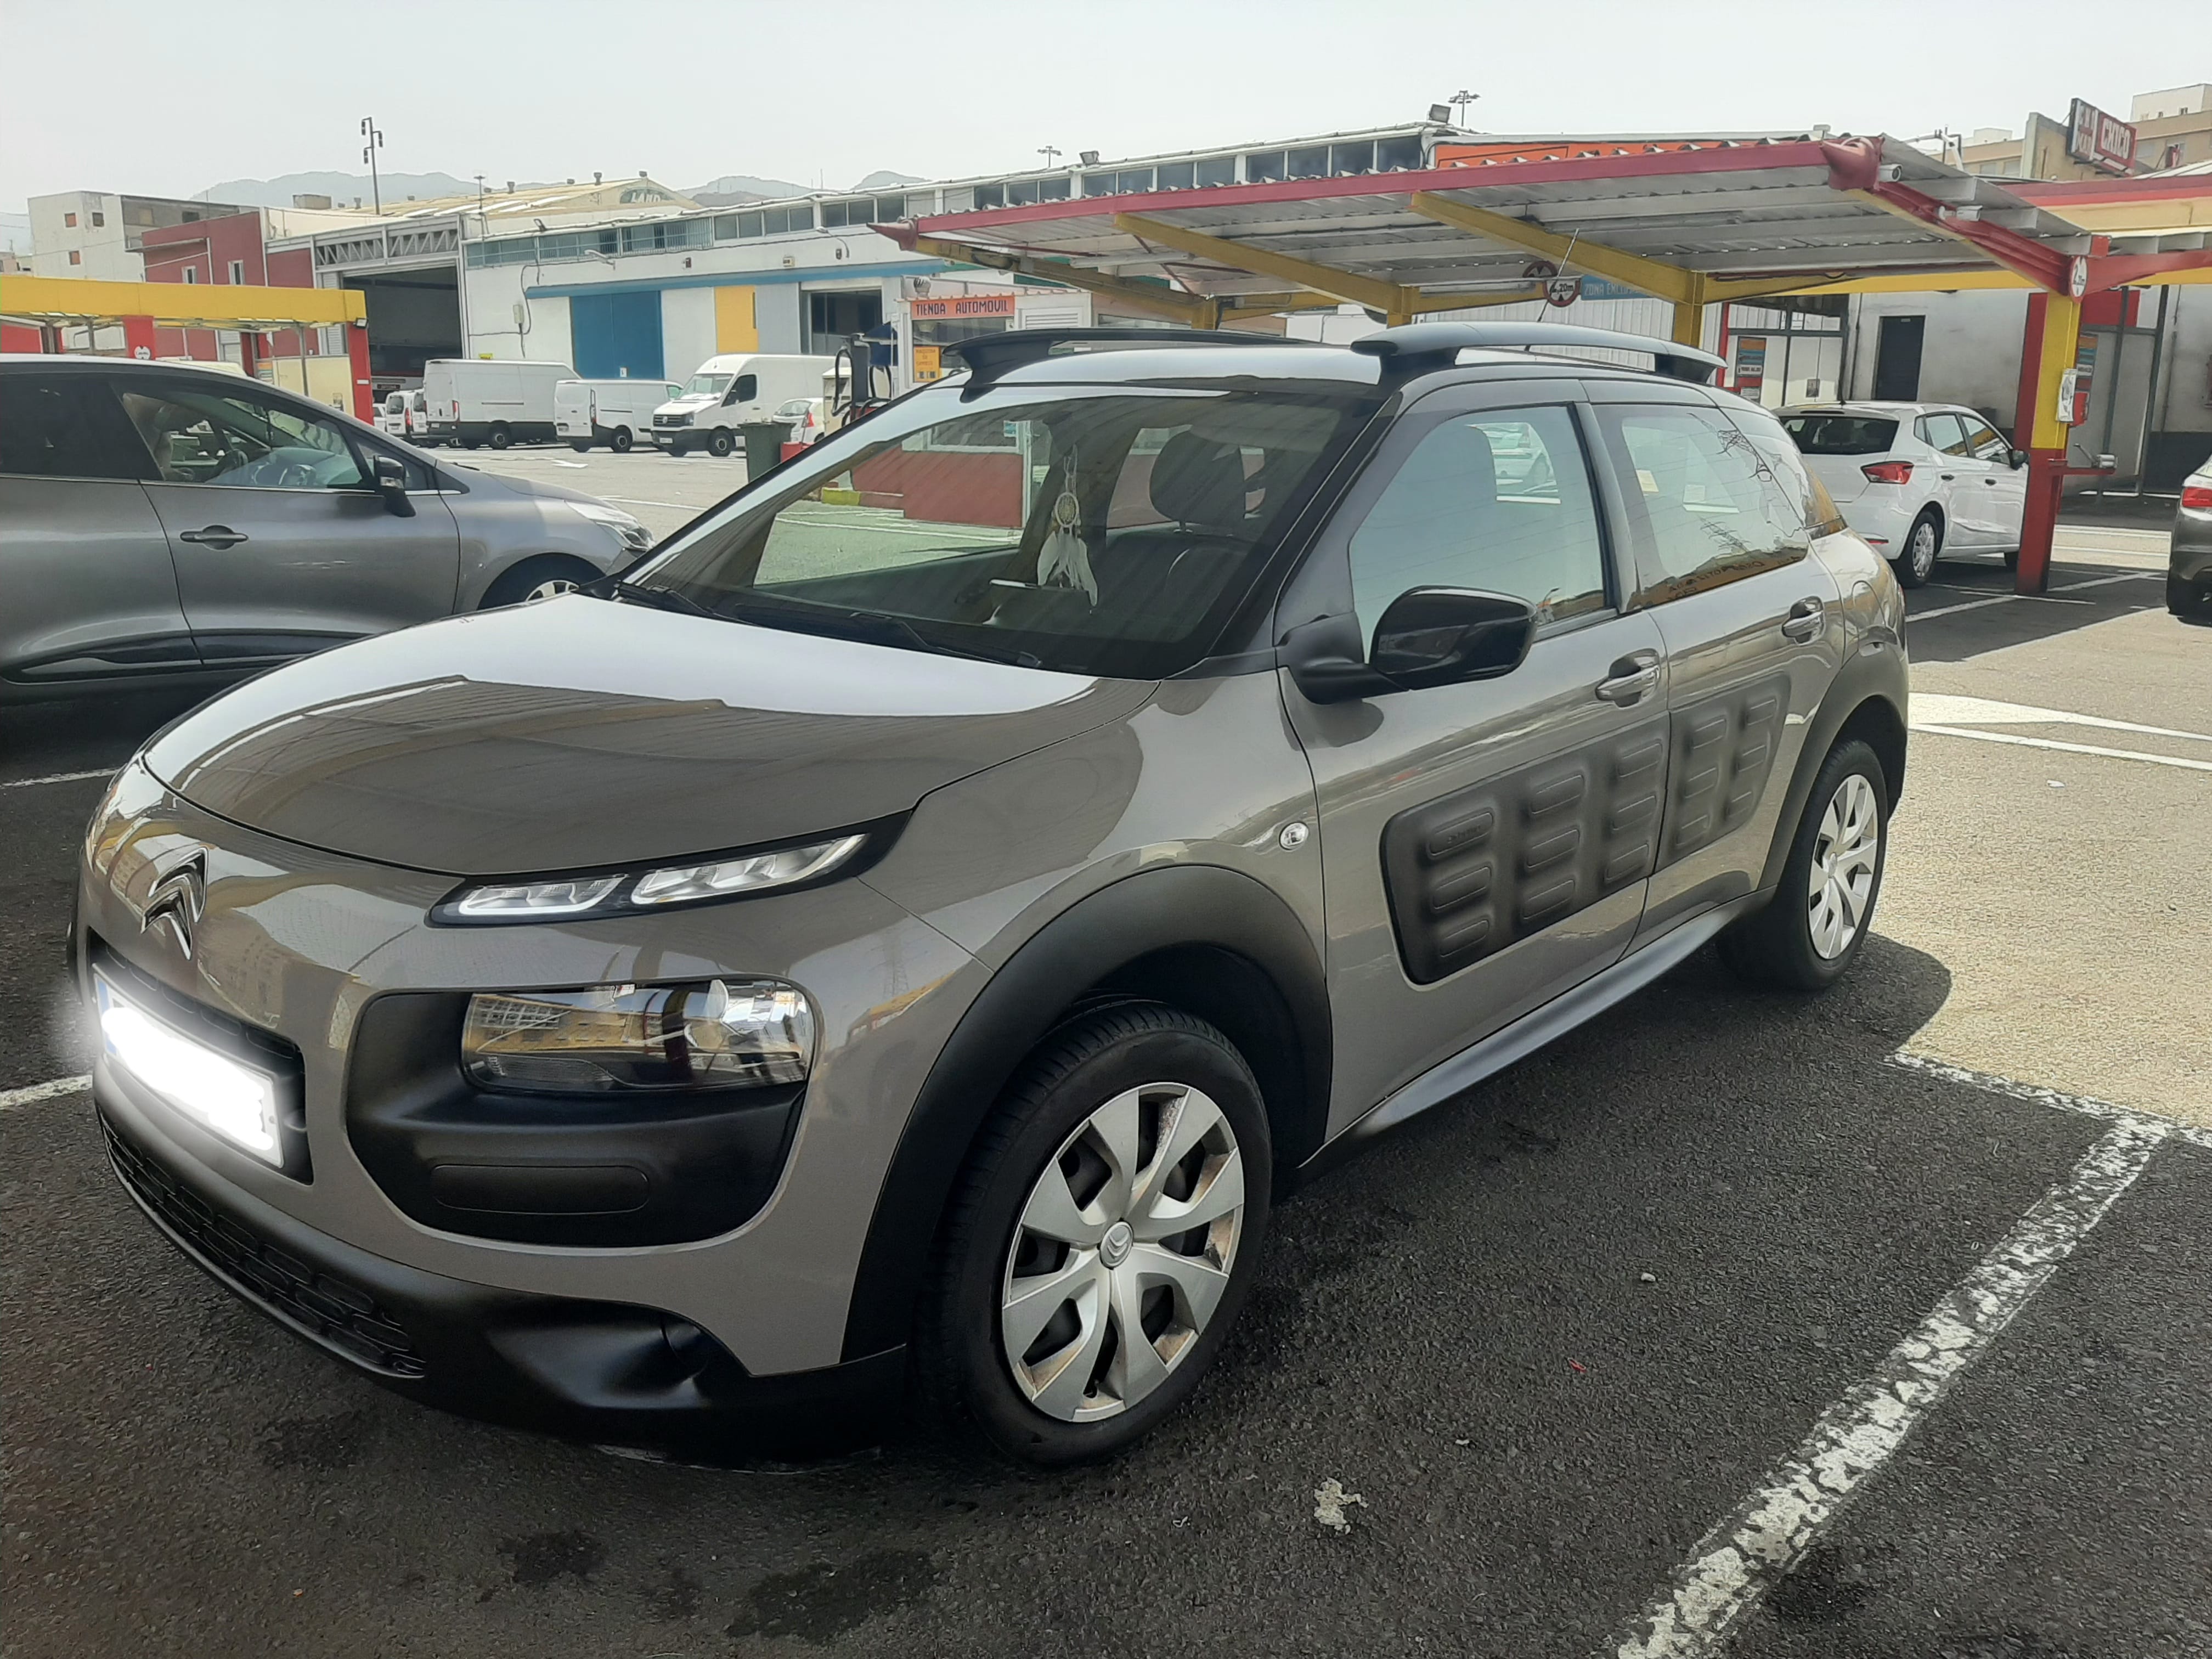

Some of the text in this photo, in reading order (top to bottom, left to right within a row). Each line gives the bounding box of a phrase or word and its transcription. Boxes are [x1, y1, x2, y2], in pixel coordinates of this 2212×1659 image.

[2101, 118, 2131, 160] CHICO
[1584, 284, 1604, 296] ZONA
[916, 300, 1008, 316] TIENDA AUTOMOVIL
